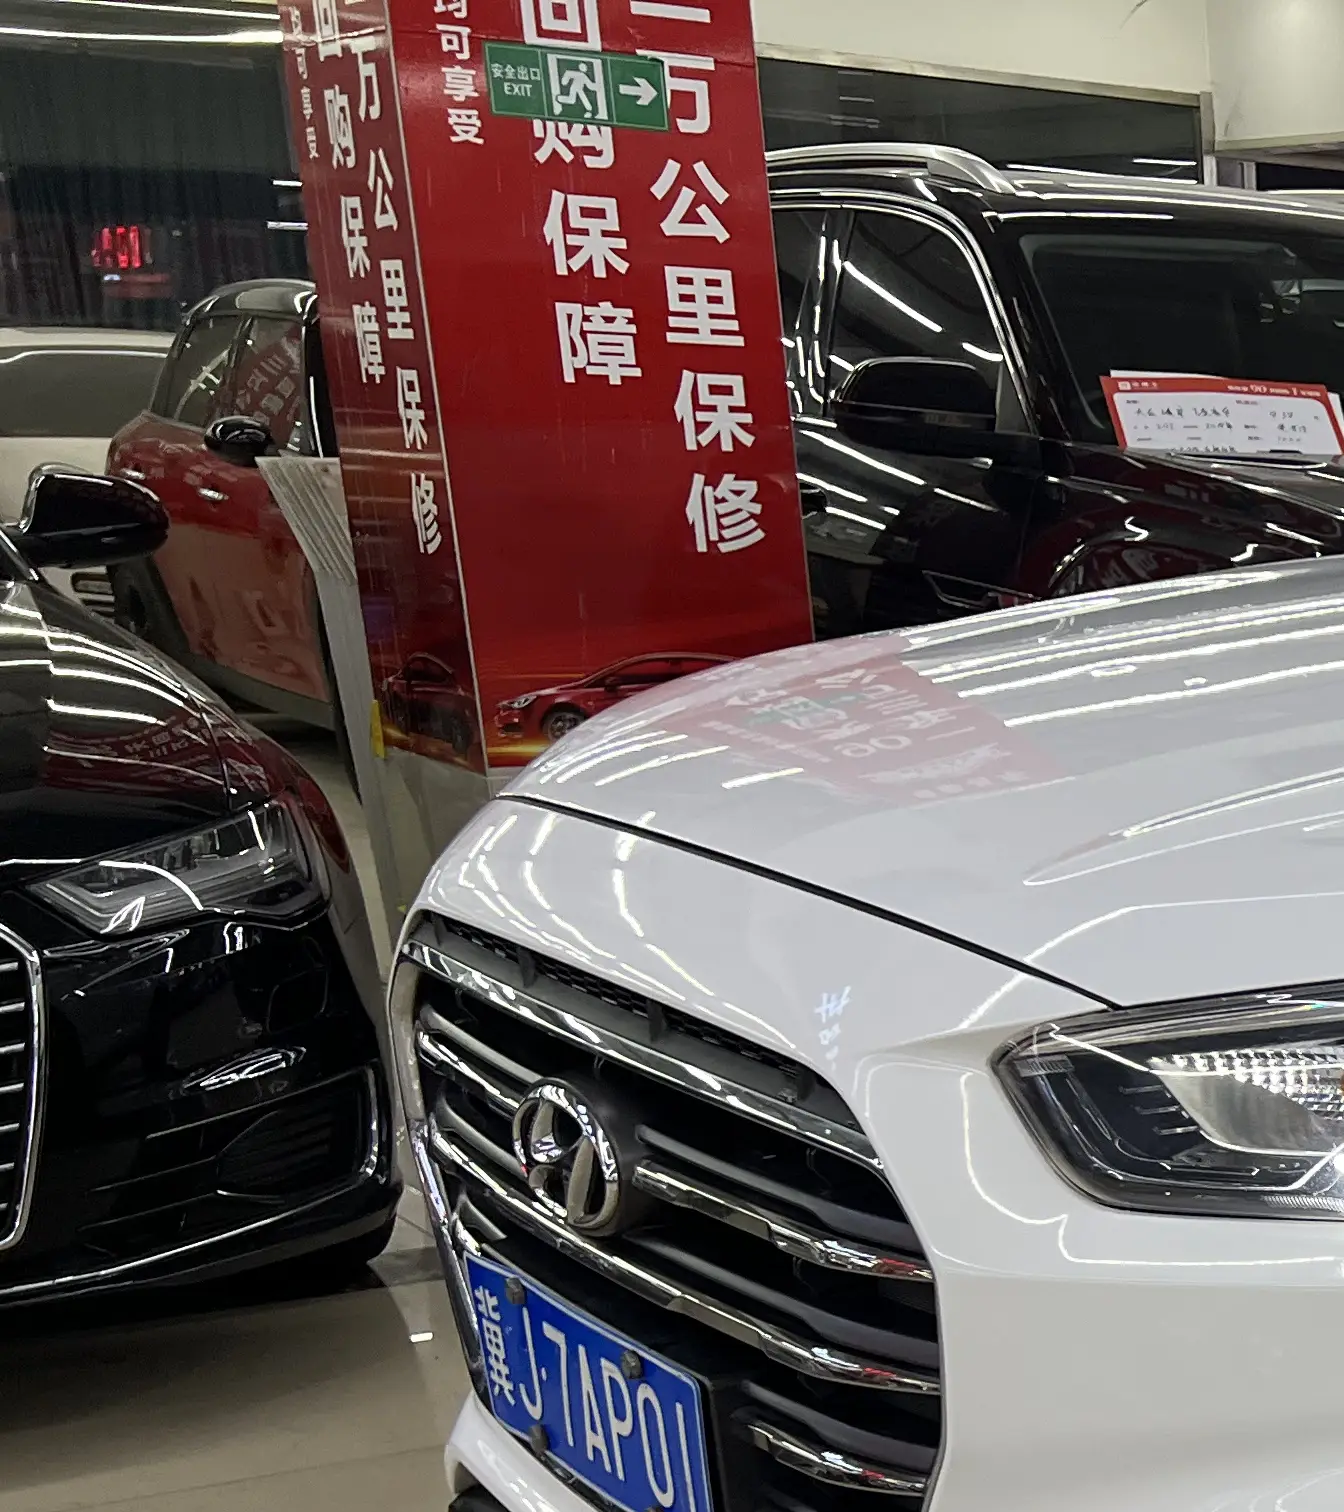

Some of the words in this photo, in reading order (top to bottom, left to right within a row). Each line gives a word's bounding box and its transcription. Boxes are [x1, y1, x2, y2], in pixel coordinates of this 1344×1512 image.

[491, 62, 541, 82] 安全出口
[504, 82, 532, 98] EXIT
[345, 0, 443, 555] 万公里保修
[630, 0, 767, 555] 万公里保修
